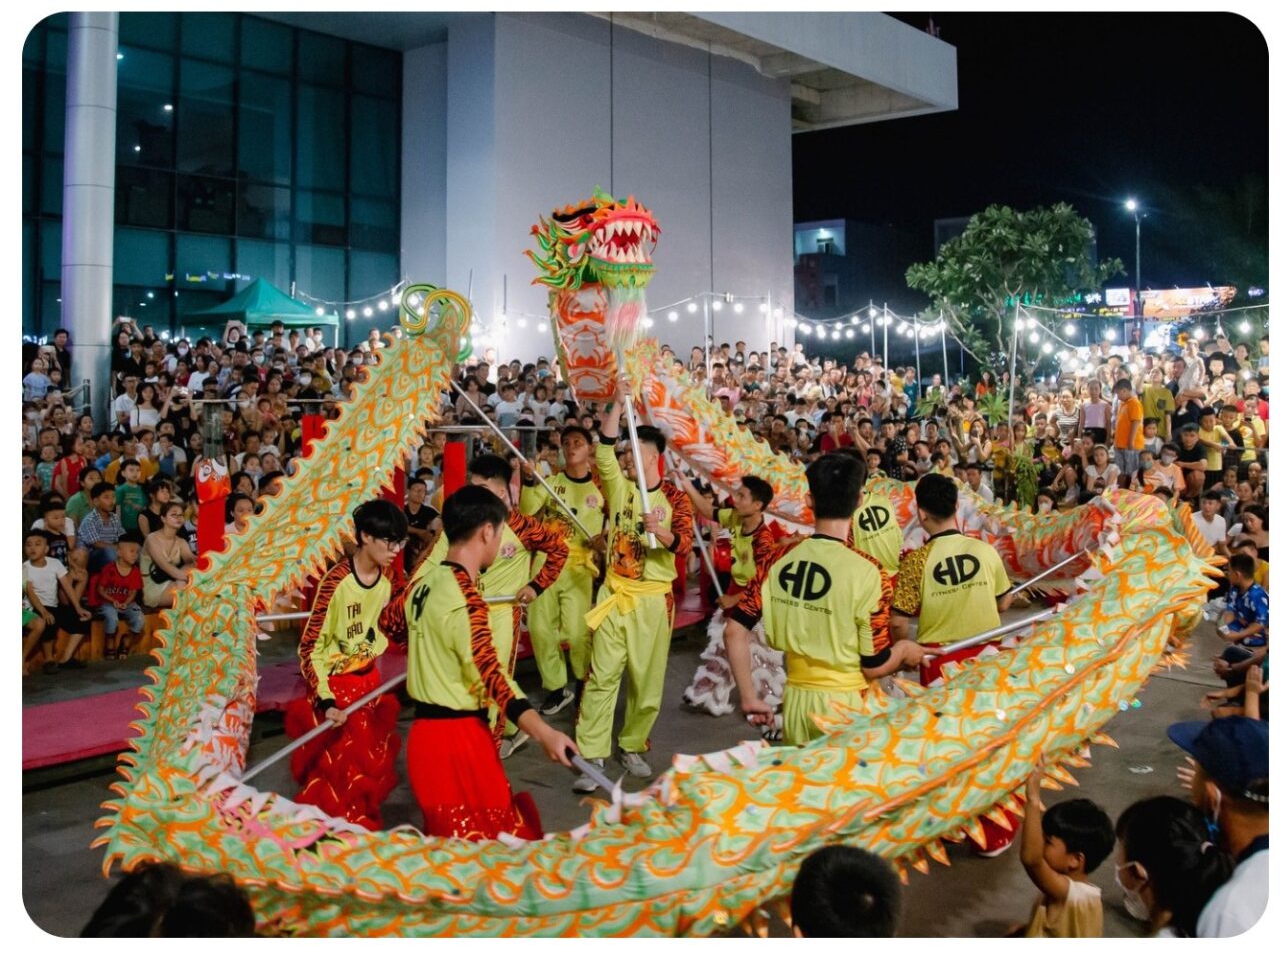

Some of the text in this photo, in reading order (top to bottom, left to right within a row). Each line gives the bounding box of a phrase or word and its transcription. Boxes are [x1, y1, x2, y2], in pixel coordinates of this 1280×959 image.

[858, 506, 890, 532] HD
[778, 560, 832, 601] HD
[932, 553, 980, 586] HD
